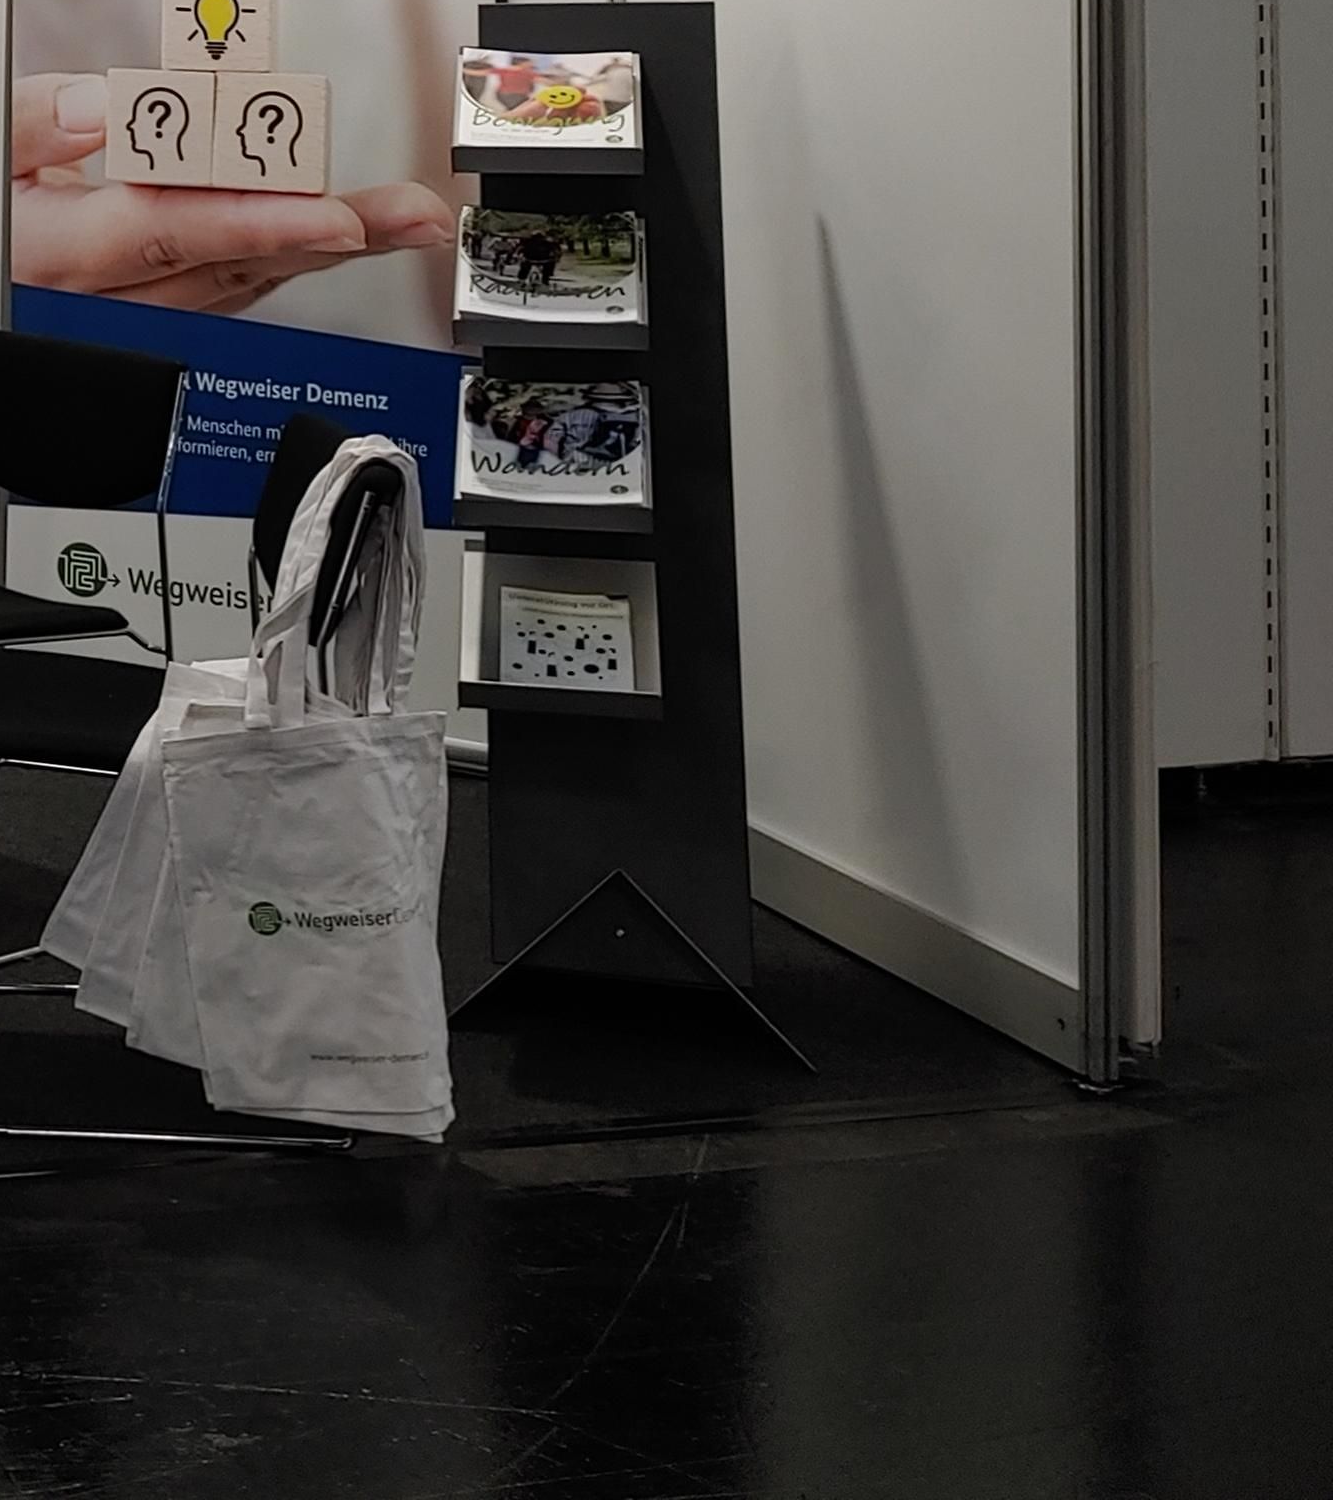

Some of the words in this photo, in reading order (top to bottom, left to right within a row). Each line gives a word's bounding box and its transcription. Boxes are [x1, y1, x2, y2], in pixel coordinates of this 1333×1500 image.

[195, 371, 301, 401] Wegweiser
[306, 383, 388, 411] Demenz
[187, 415, 261, 440] Menschen
[177, 437, 252, 463] formieren,
[470, 450, 629, 477] Wandern
